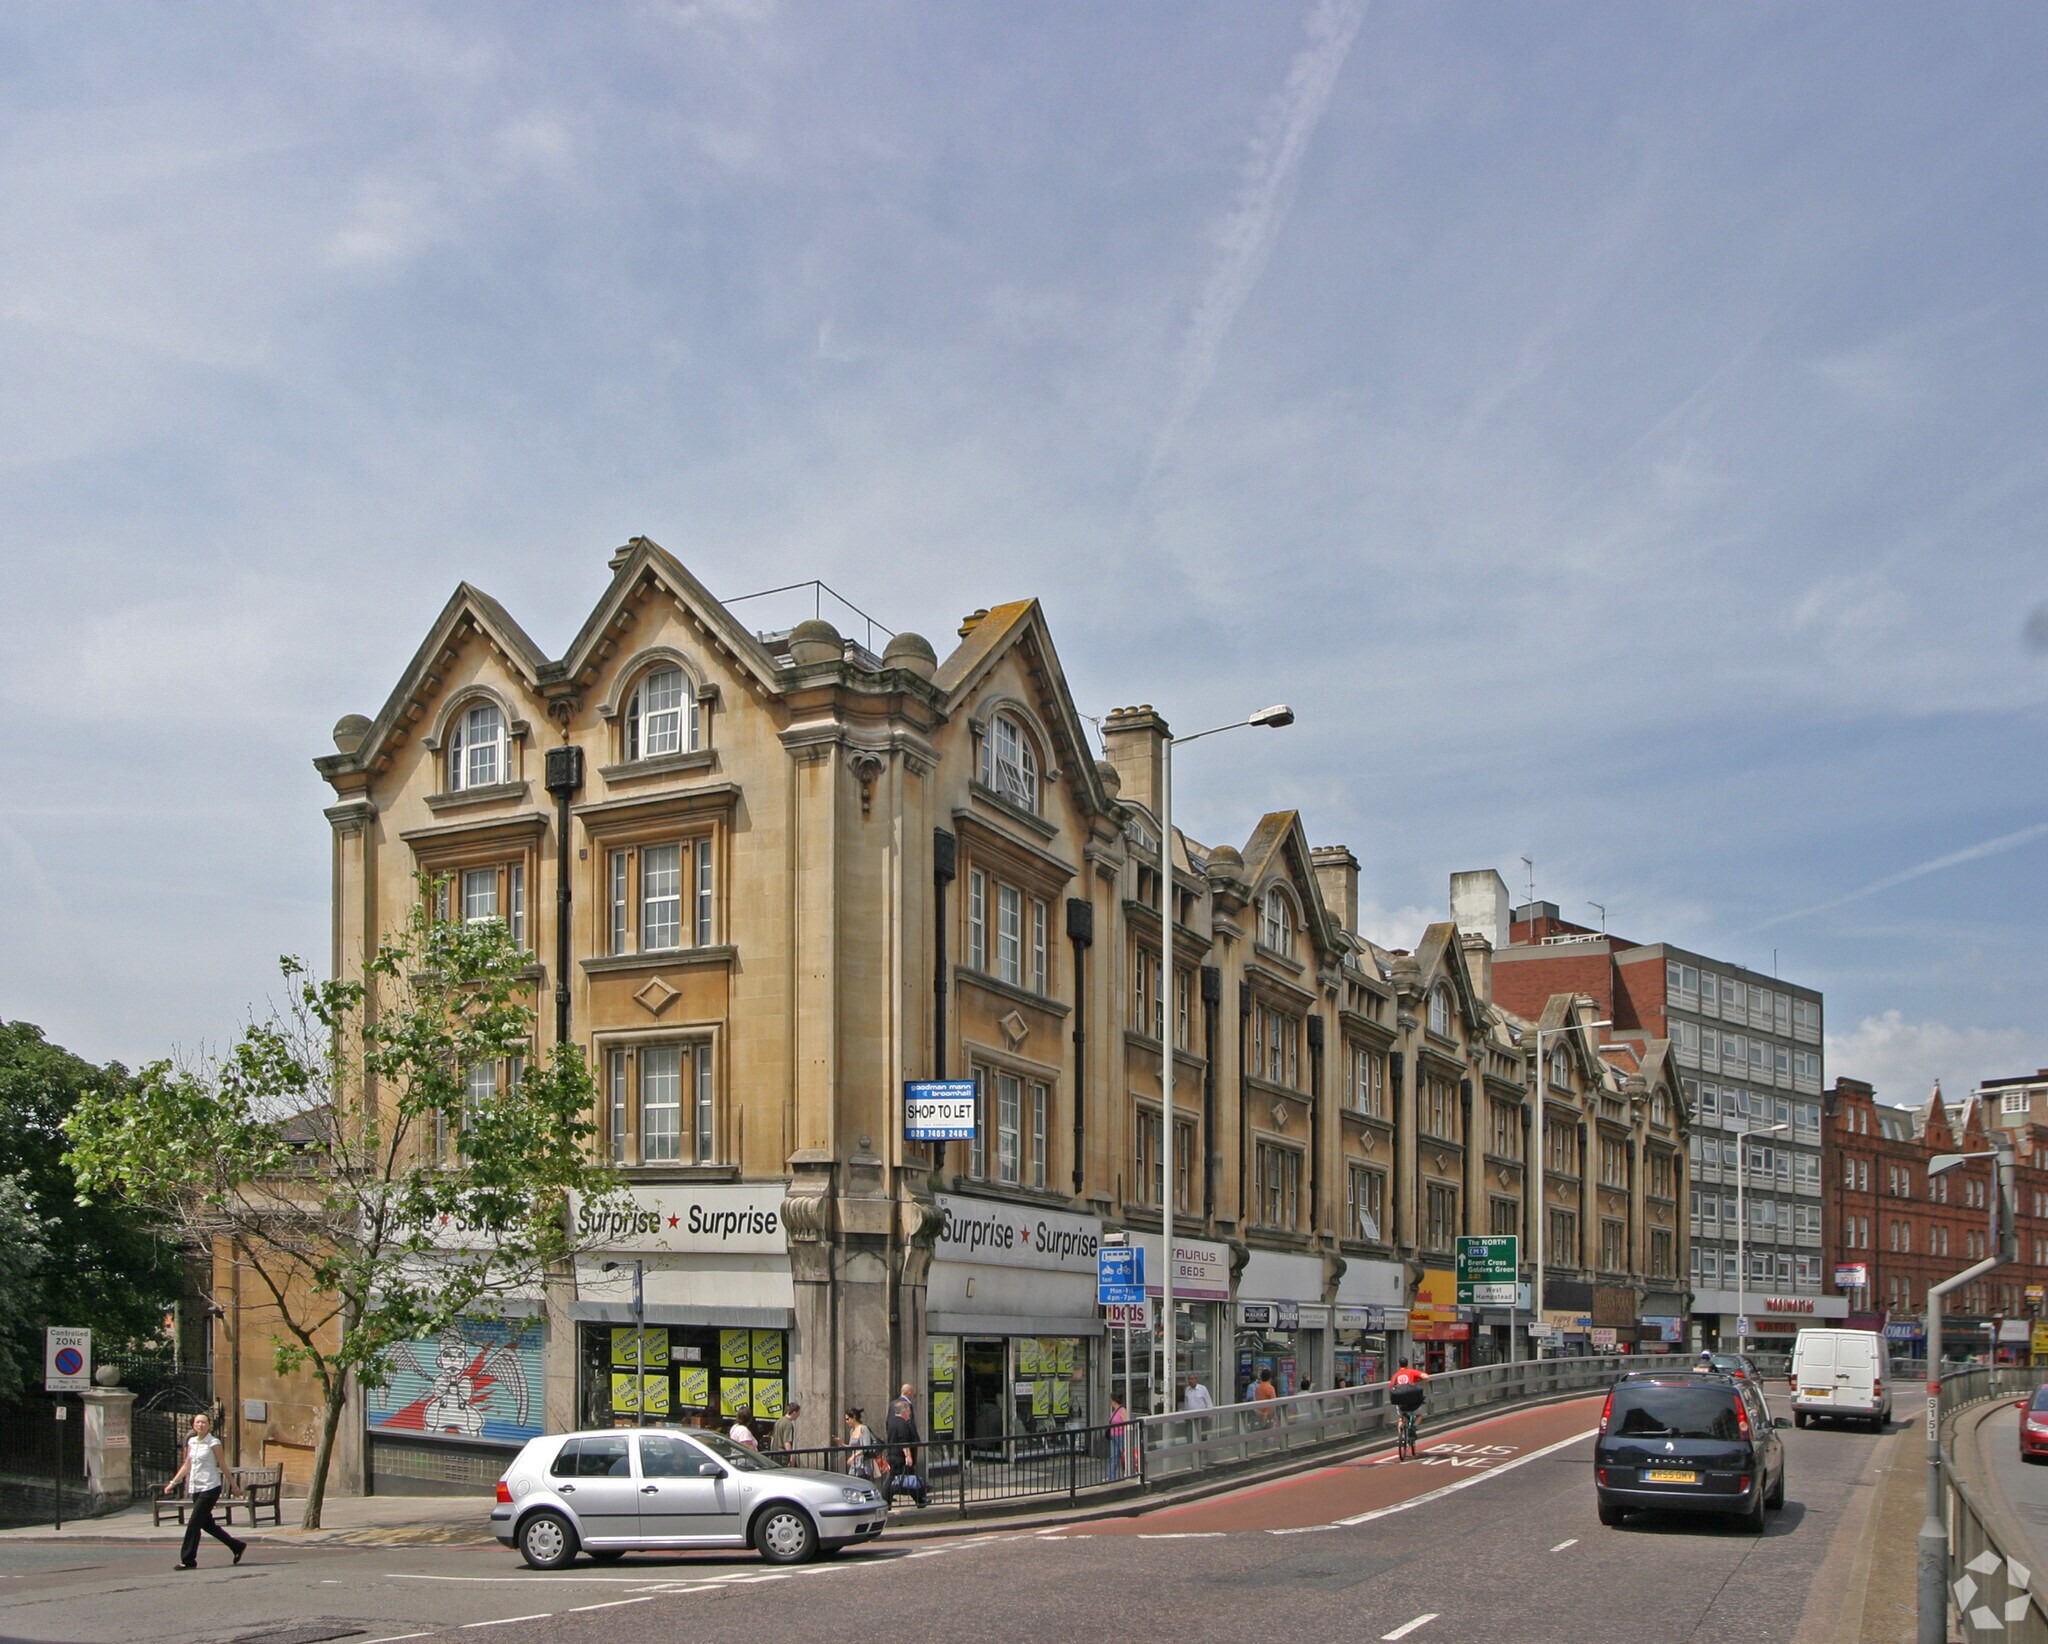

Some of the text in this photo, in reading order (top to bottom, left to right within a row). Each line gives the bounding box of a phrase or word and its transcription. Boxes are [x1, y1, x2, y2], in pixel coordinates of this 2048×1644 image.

[908, 1105, 971, 1118] SHOP TO LET
[911, 1129, 968, 1137] 020 7409 2484
[578, 1204, 778, 1240] Surprise Surprise
[940, 1208, 1098, 1261] Surprise Surprise
[1180, 1265, 1205, 1277] BEDS
[1766, 1298, 1815, 1313] WOOLWORTHS
[1279, 1312, 1299, 1321] HALIFAX
[50, 1329, 89, 1338] Controlled
[613, 1329, 637, 1349] CLOSING
[1886, 1325, 1911, 1338] CORAL
[56, 1338, 83, 1346] ZONE
[721, 1330, 747, 1351] CLOSING
[754, 1333, 779, 1352] CLOSING
[614, 1375, 637, 1395] CLOSING
[681, 1369, 706, 1388] CLOSING
[754, 1381, 780, 1400] CLOSING
[1928, 1399, 1936, 1439] S151
[1422, 1443, 1520, 1455] BUS
